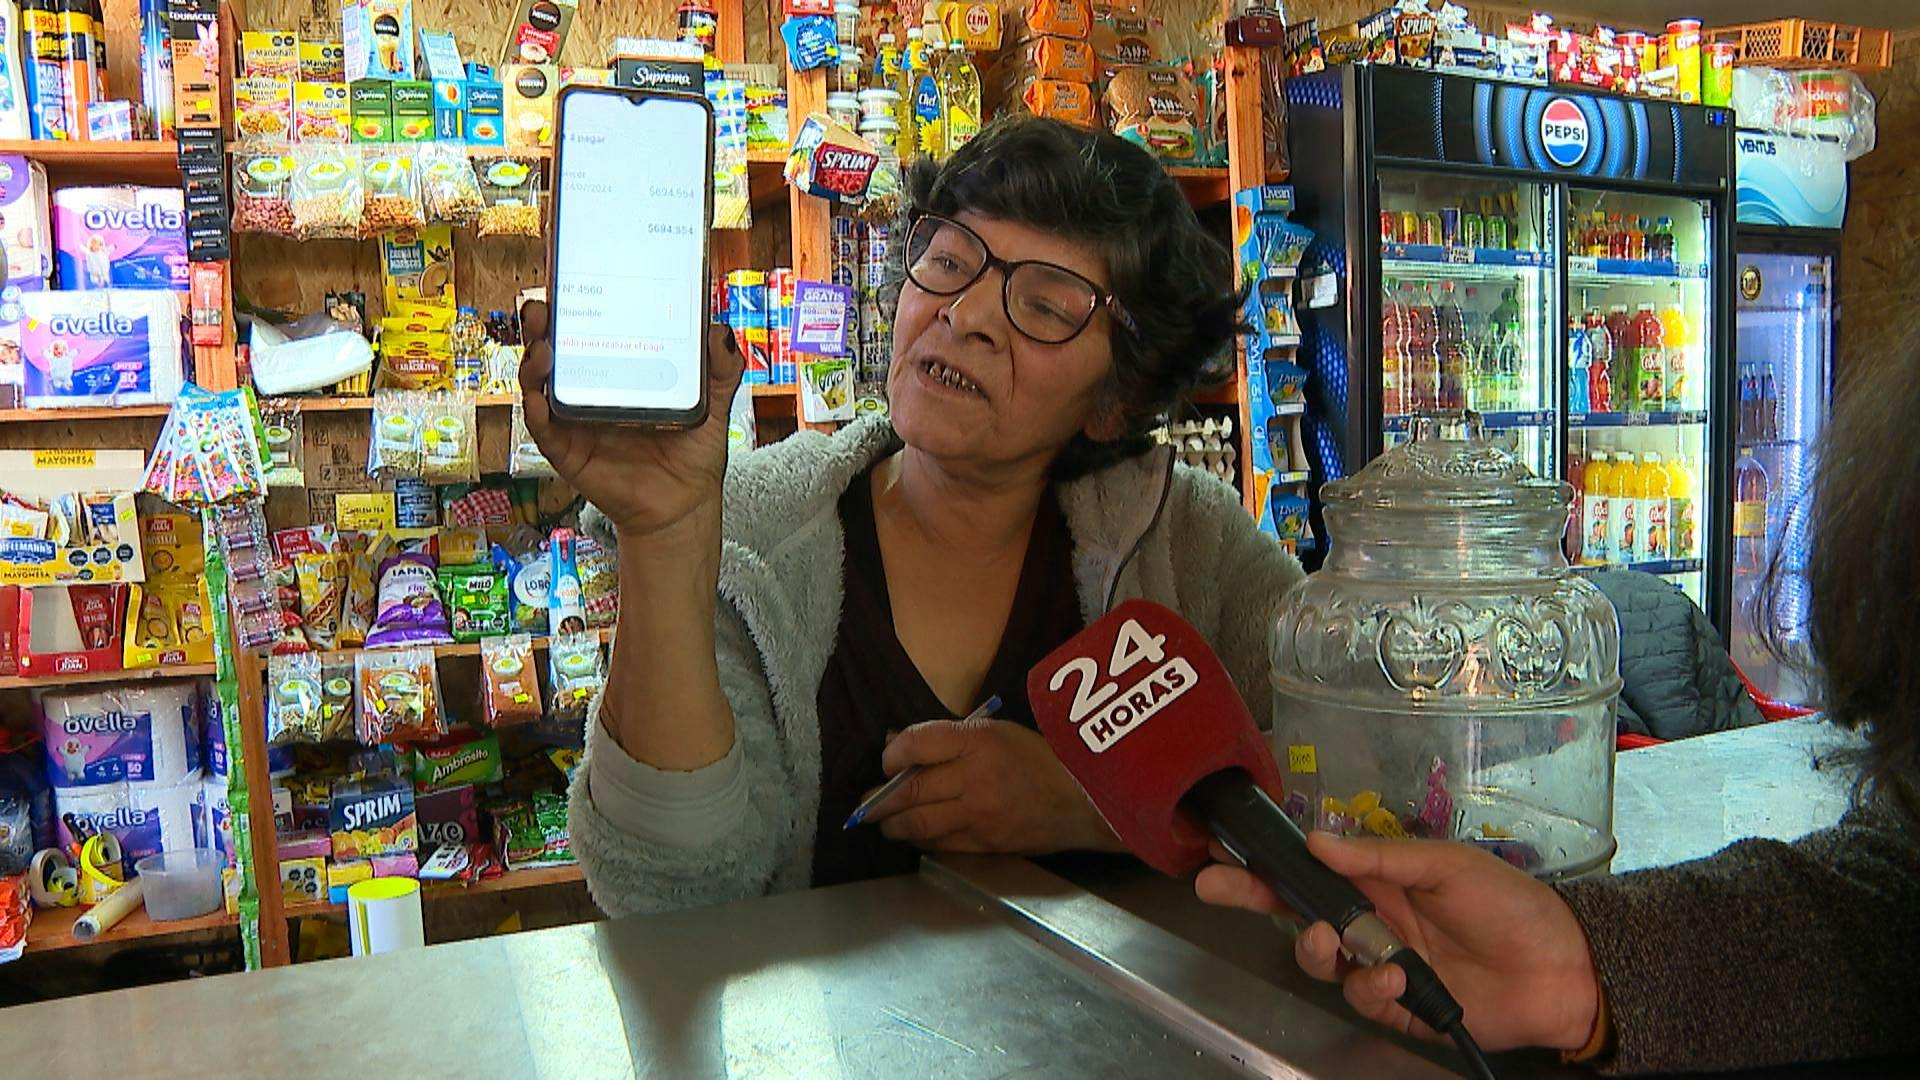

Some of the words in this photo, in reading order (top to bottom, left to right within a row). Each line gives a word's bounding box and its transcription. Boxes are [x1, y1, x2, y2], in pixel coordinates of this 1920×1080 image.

[1400, 18, 1431, 36] SPRIM
[1545, 124, 1585, 141] PEPSI
[1738, 138, 1776, 155] VENTUS
[821, 151, 872, 171] SPRIM
[1263, 186, 1291, 199] Livean
[85, 203, 183, 231] ovella
[578, 284, 603, 295] 4560
[803, 291, 845, 303] GRATIS
[559, 307, 602, 319] Disponible
[50, 311, 133, 336] ovella
[820, 343, 843, 353] WOM
[37, 455, 95, 465] MAYONESA
[1049, 618, 1167, 723] 24
[1089, 666, 1187, 744] HORAS
[64, 711, 138, 734] ovella
[432, 748, 489, 782] Ambrosito
[73, 807, 147, 833] ovella
[343, 793, 401, 831] SPRIM
